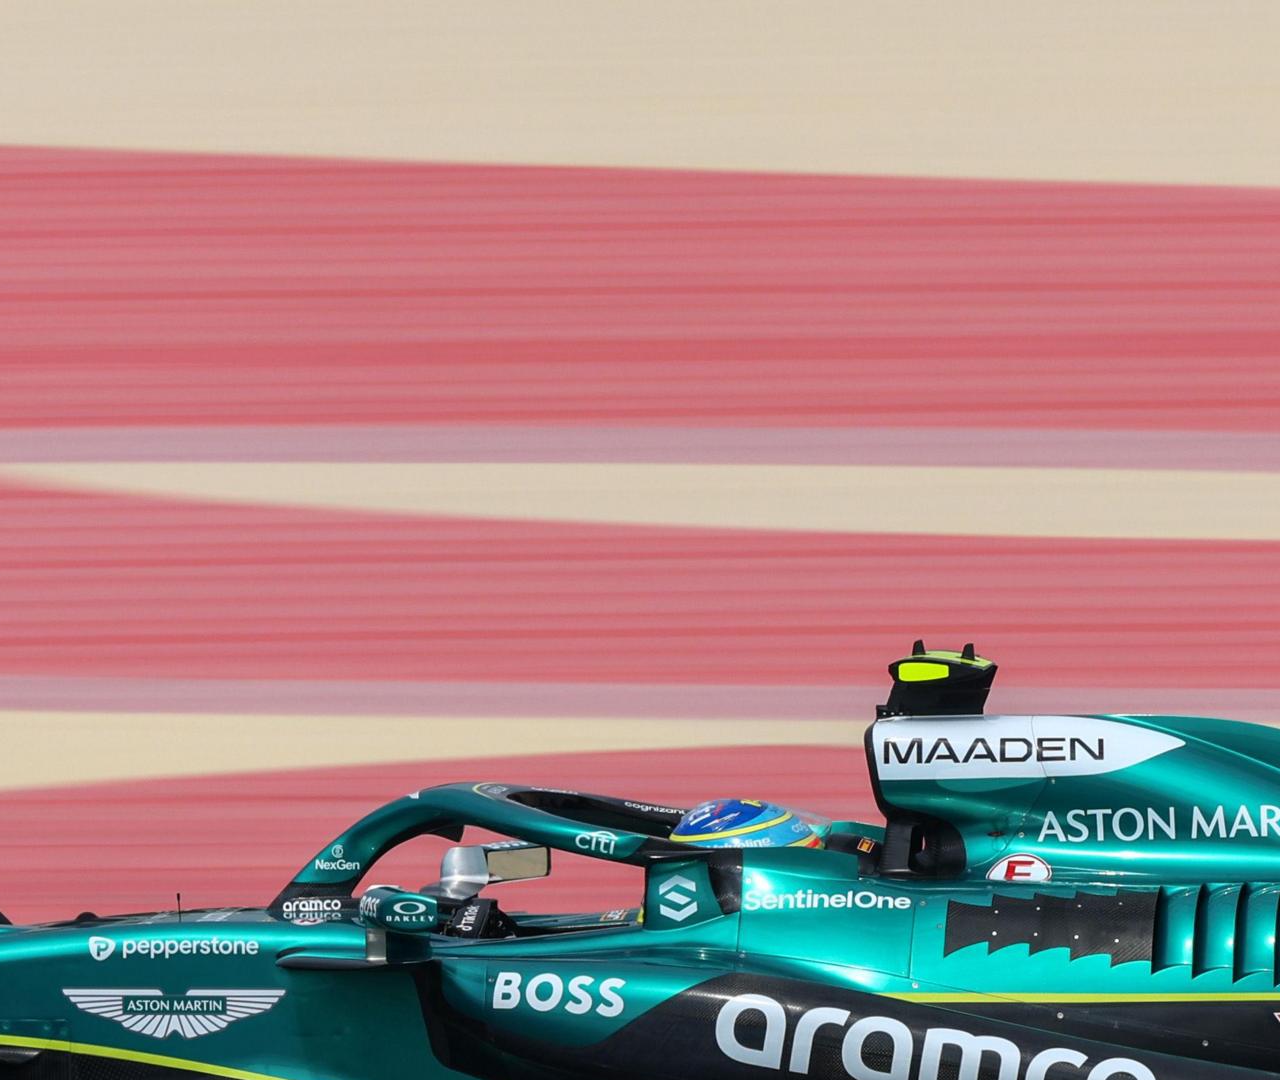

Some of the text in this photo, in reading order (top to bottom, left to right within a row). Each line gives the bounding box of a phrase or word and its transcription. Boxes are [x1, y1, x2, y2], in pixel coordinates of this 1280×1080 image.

[883, 737, 1104, 765] MAADEN
[624, 801, 687, 815] cognizant
[1037, 807, 1176, 843] ASTON
[315, 859, 360, 871] NexGen
[282, 899, 342, 912] aramco
[743, 889, 911, 909] SentinelOne
[123, 938, 259, 959] pepperstone
[492, 972, 627, 1017] BOSS
[127, 1001, 223, 1011] ASTON MARTIN
